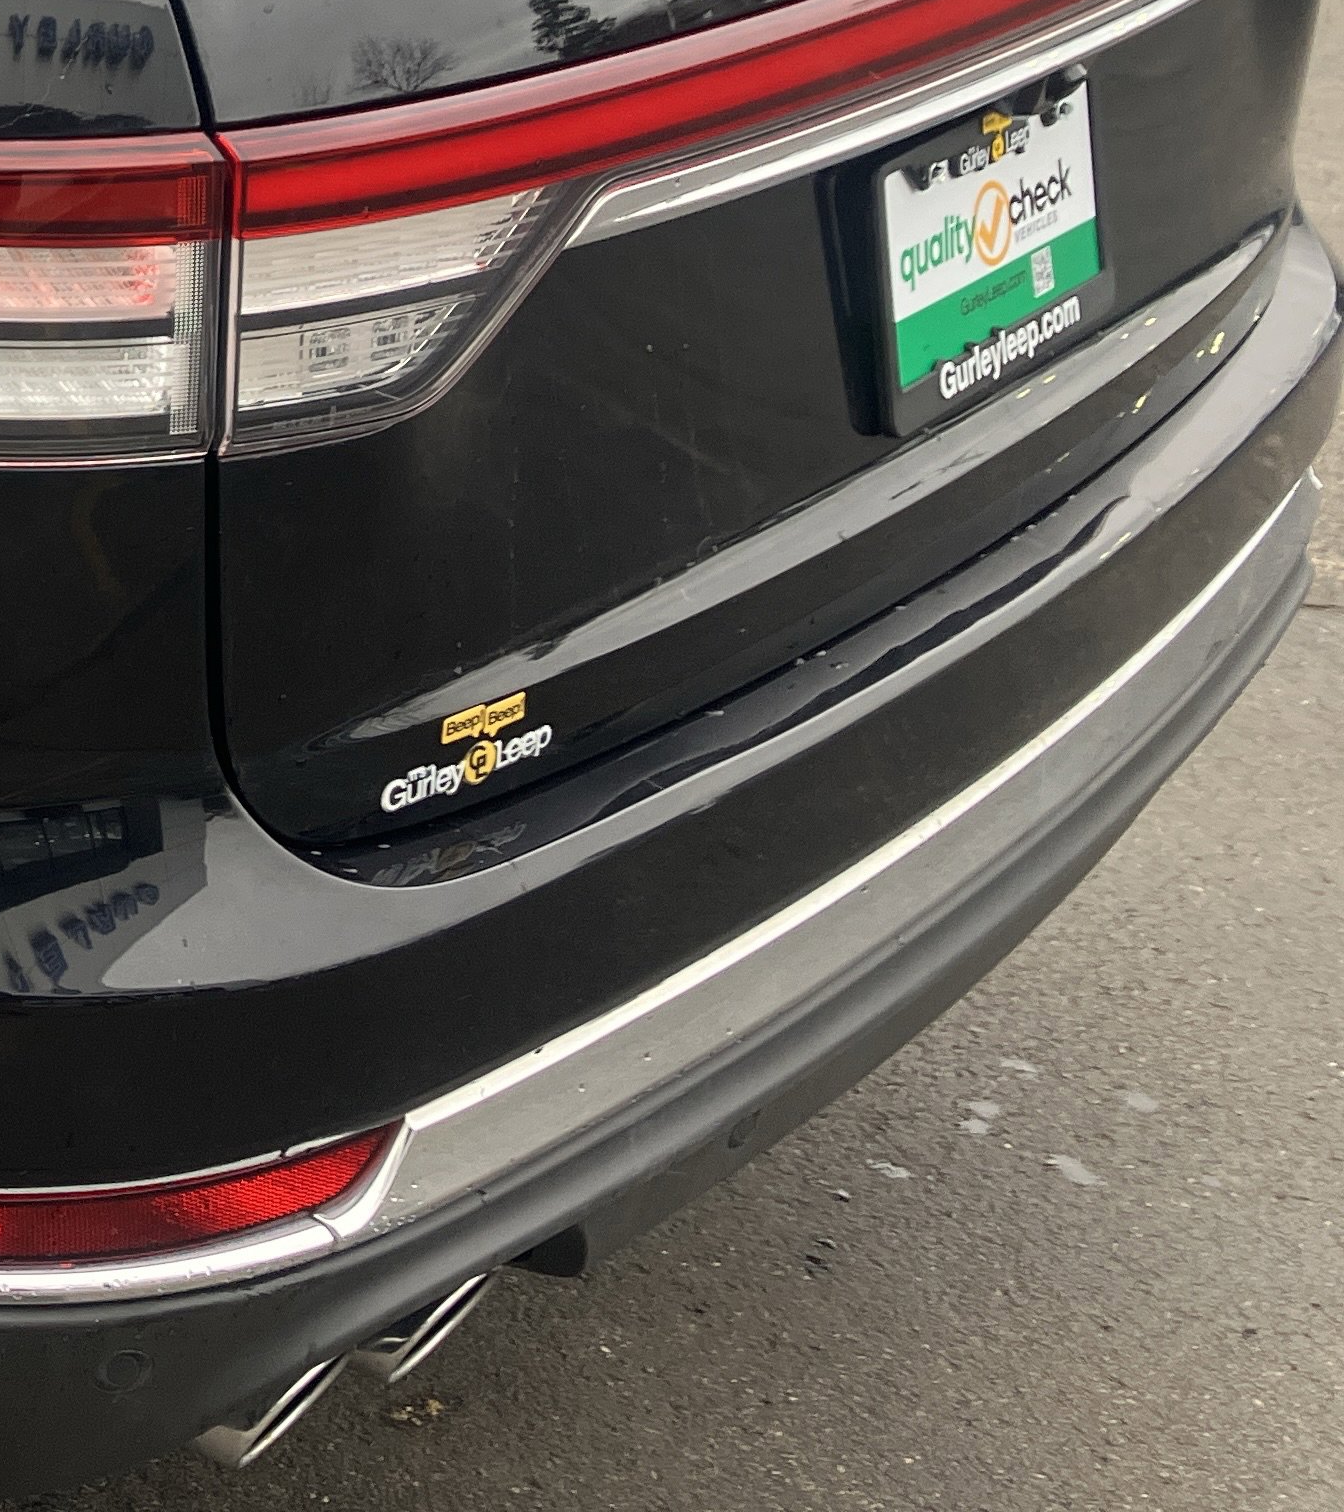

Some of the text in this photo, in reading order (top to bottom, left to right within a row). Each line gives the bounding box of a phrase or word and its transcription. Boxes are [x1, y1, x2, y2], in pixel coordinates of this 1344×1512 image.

[900, 158, 1072, 292] quality check
[1014, 210, 1058, 243] VEHICLES
[380, 760, 465, 813] Gurley
[494, 724, 552, 772] Leep
